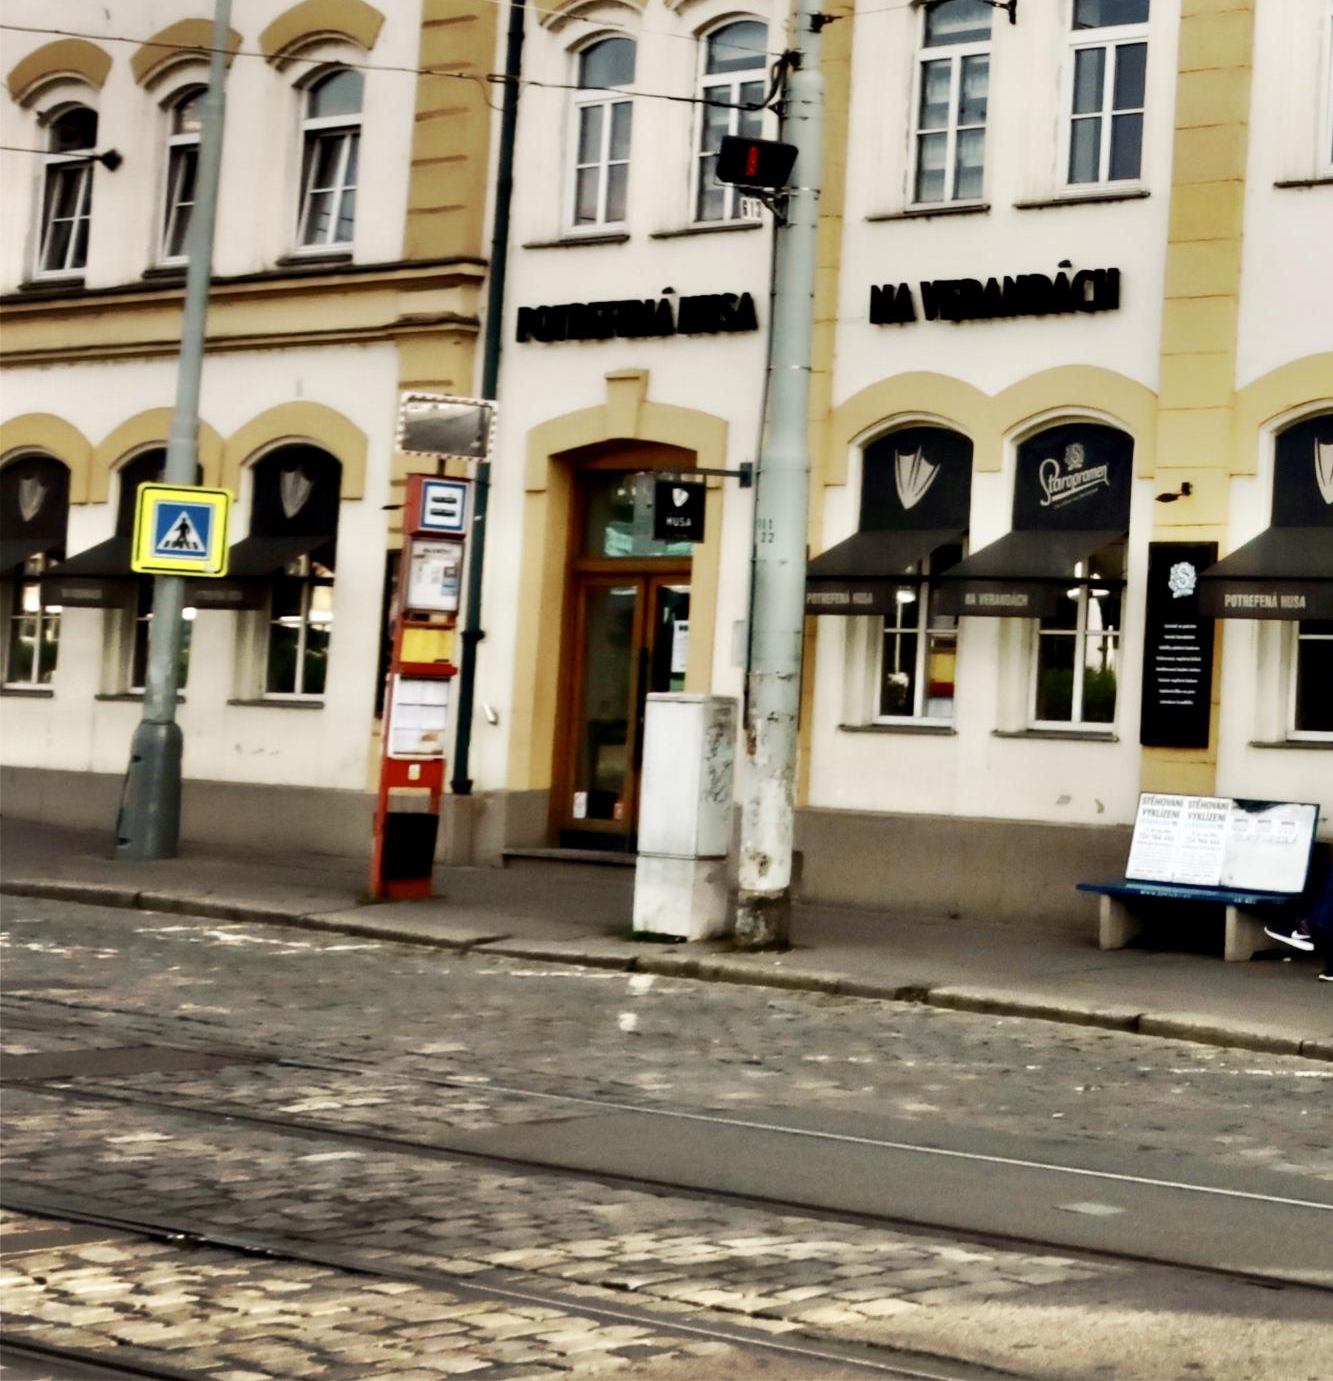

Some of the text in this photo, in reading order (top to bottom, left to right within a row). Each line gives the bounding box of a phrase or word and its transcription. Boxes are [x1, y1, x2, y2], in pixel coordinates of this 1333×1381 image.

[869, 259, 1121, 324] NA VERANDÁCH
[1039, 458, 1110, 506] Staropramen
[1224, 593, 1306, 608] POTREFENÁ HUSA
